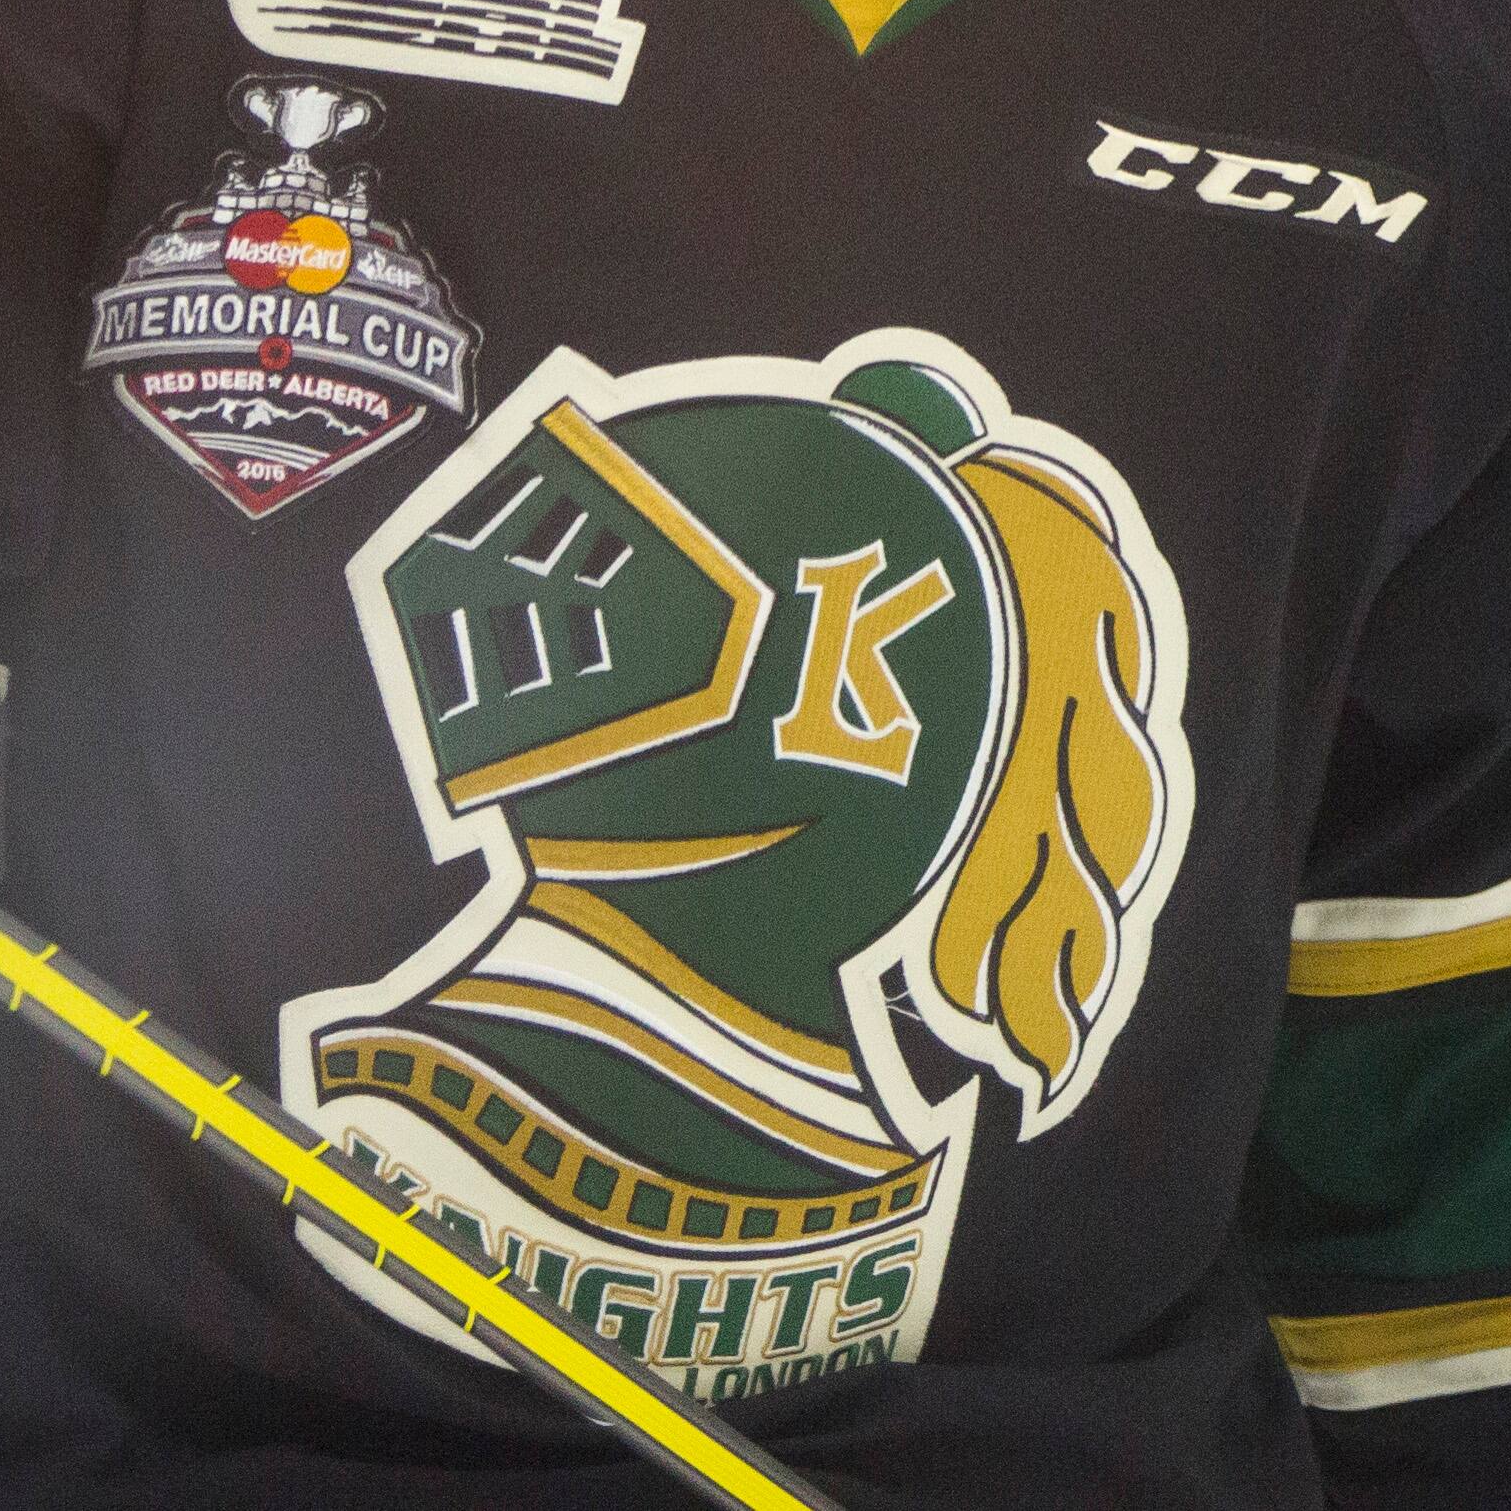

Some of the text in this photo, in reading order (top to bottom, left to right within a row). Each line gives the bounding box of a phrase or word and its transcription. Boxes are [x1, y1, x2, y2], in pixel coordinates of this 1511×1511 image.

[1086, 119, 1429, 243] CCM
[224, 235, 348, 271] MasterCard
[102, 292, 451, 377] MEMORIAL CUP
[143, 369, 390, 421] RED DEER ALBERTA
[236, 460, 287, 483] 2016
[772, 539, 955, 787] K
[345, 1128, 923, 1366] IGHTS
